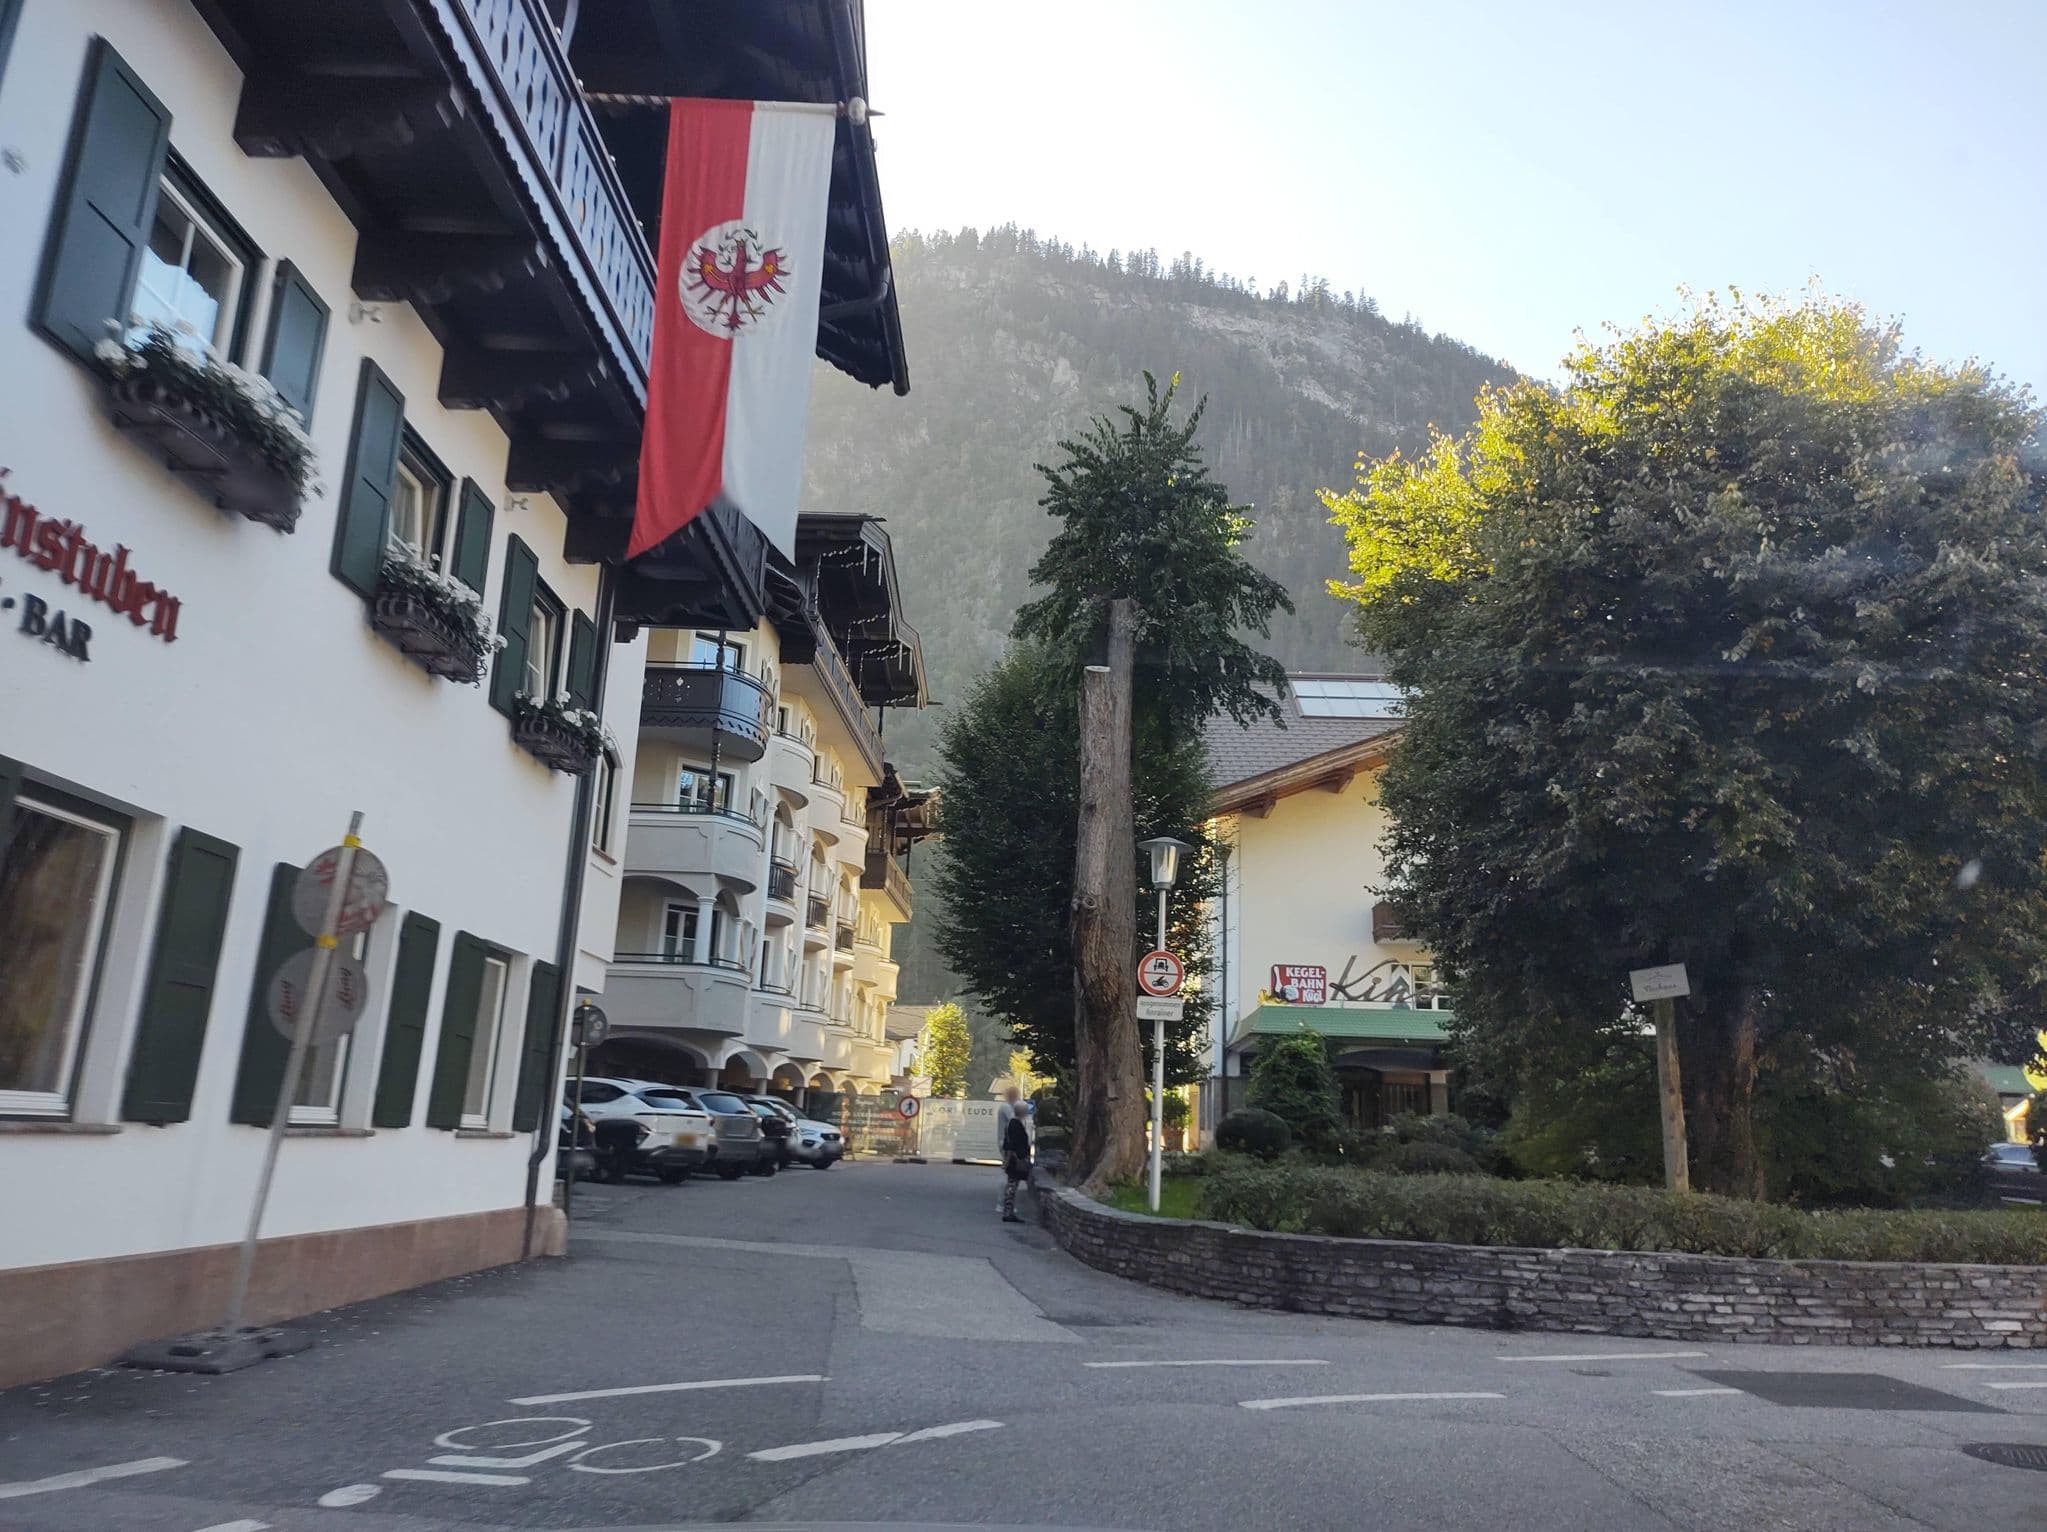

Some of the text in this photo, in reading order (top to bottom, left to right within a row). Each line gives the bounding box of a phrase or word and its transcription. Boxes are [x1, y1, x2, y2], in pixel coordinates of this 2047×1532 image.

[19, 592, 93, 662] BAR
[1285, 966, 1326, 979] KEGEL-
[1290, 978, 1324, 989] BAHN
